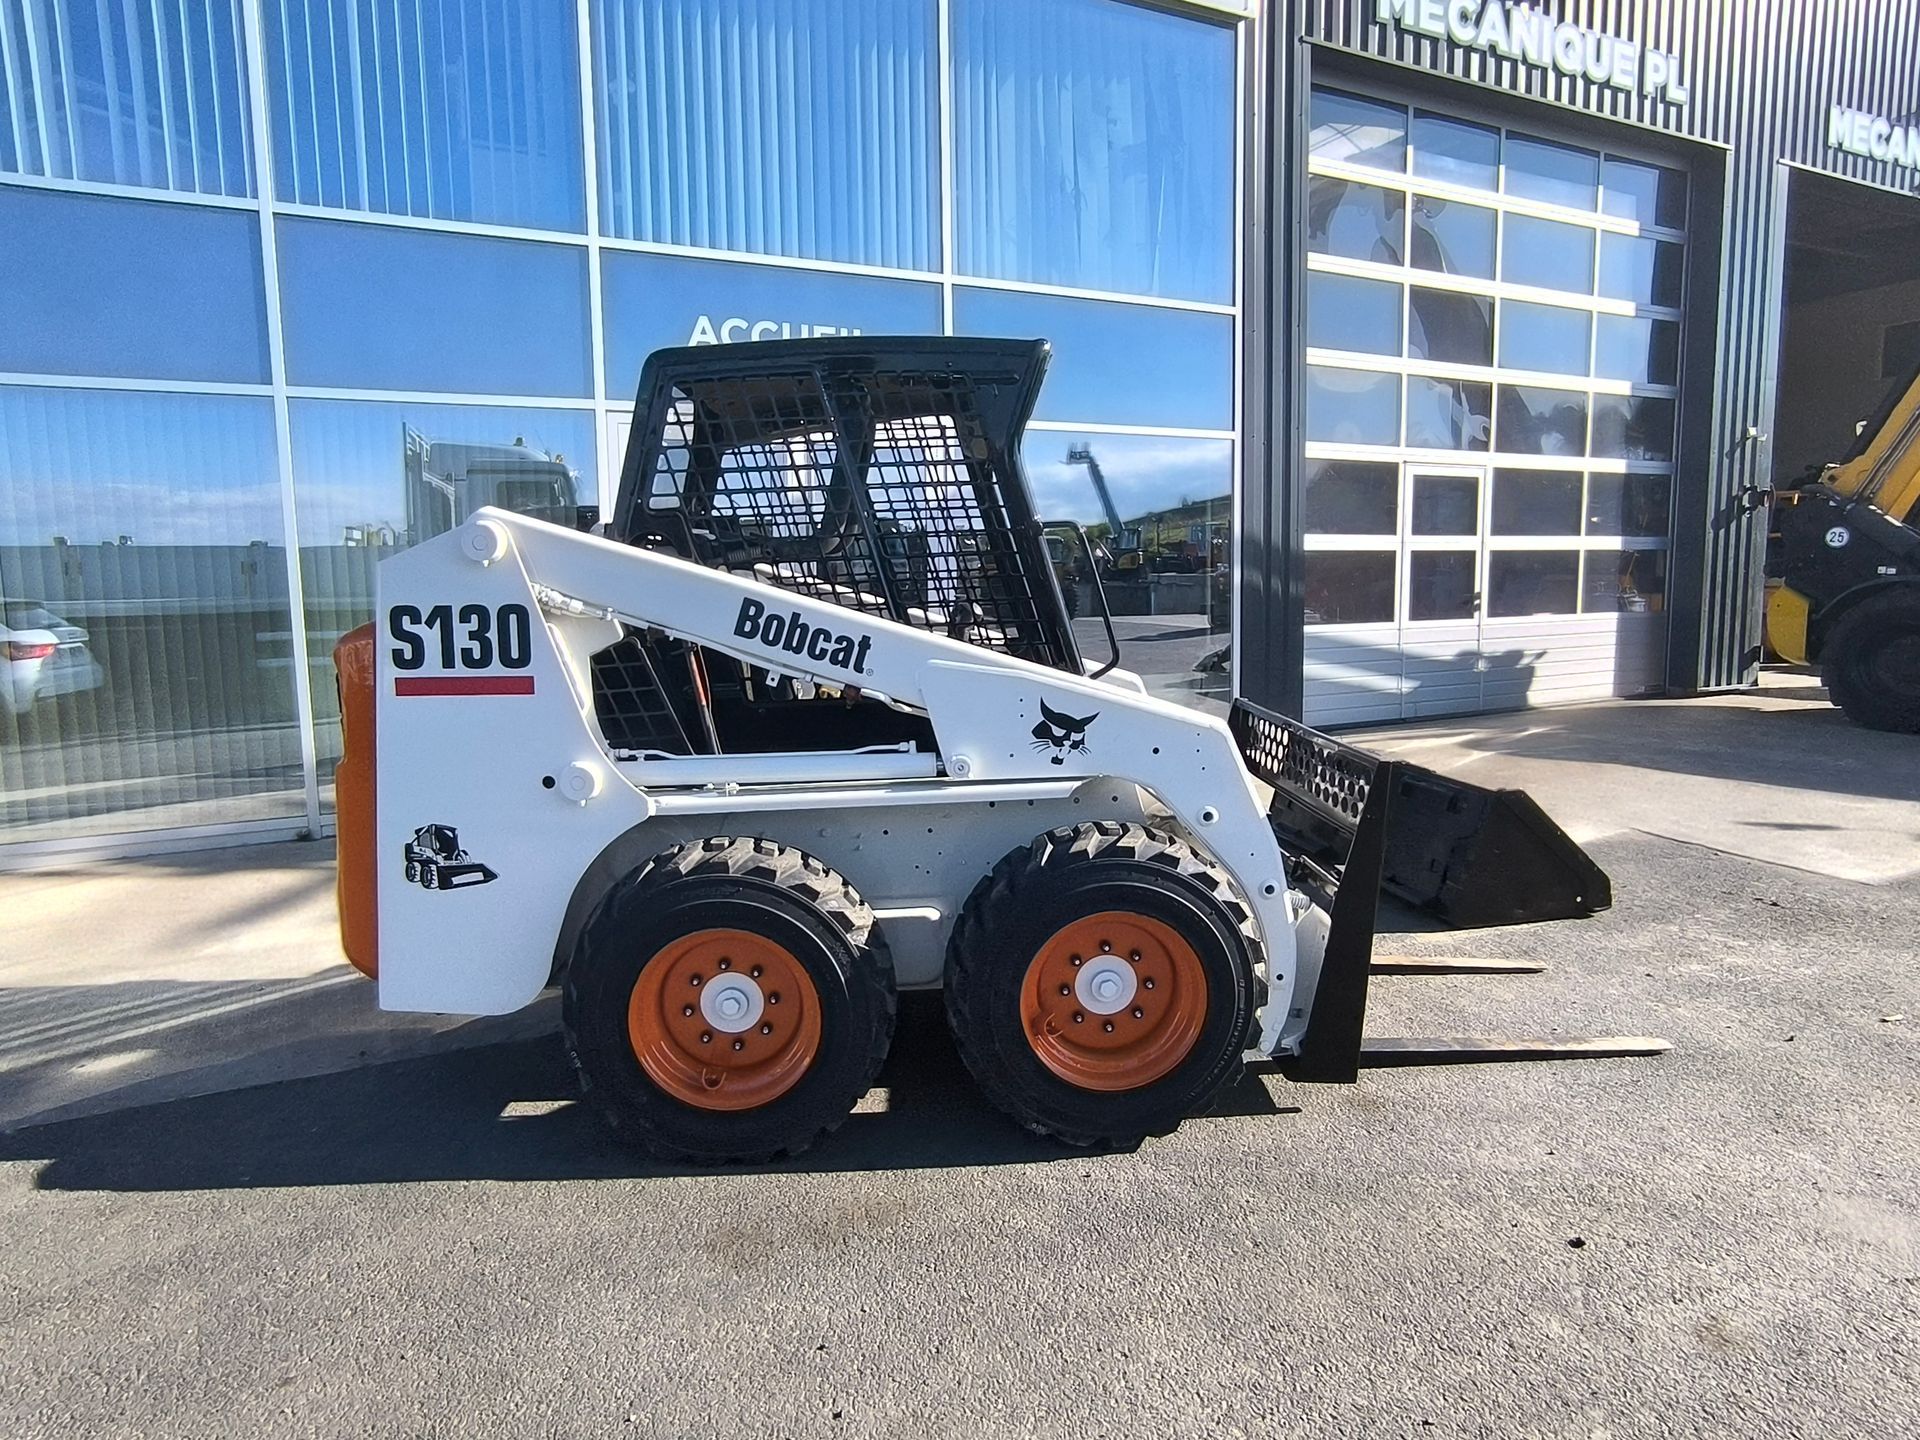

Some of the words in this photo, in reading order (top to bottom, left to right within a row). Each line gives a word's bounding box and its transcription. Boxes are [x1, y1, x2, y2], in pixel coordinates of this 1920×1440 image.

[1643, 48, 1687, 104] PL
[1829, 531, 1844, 543] 25
[389, 604, 532, 670] S130
[734, 597, 872, 674] Bobcat
